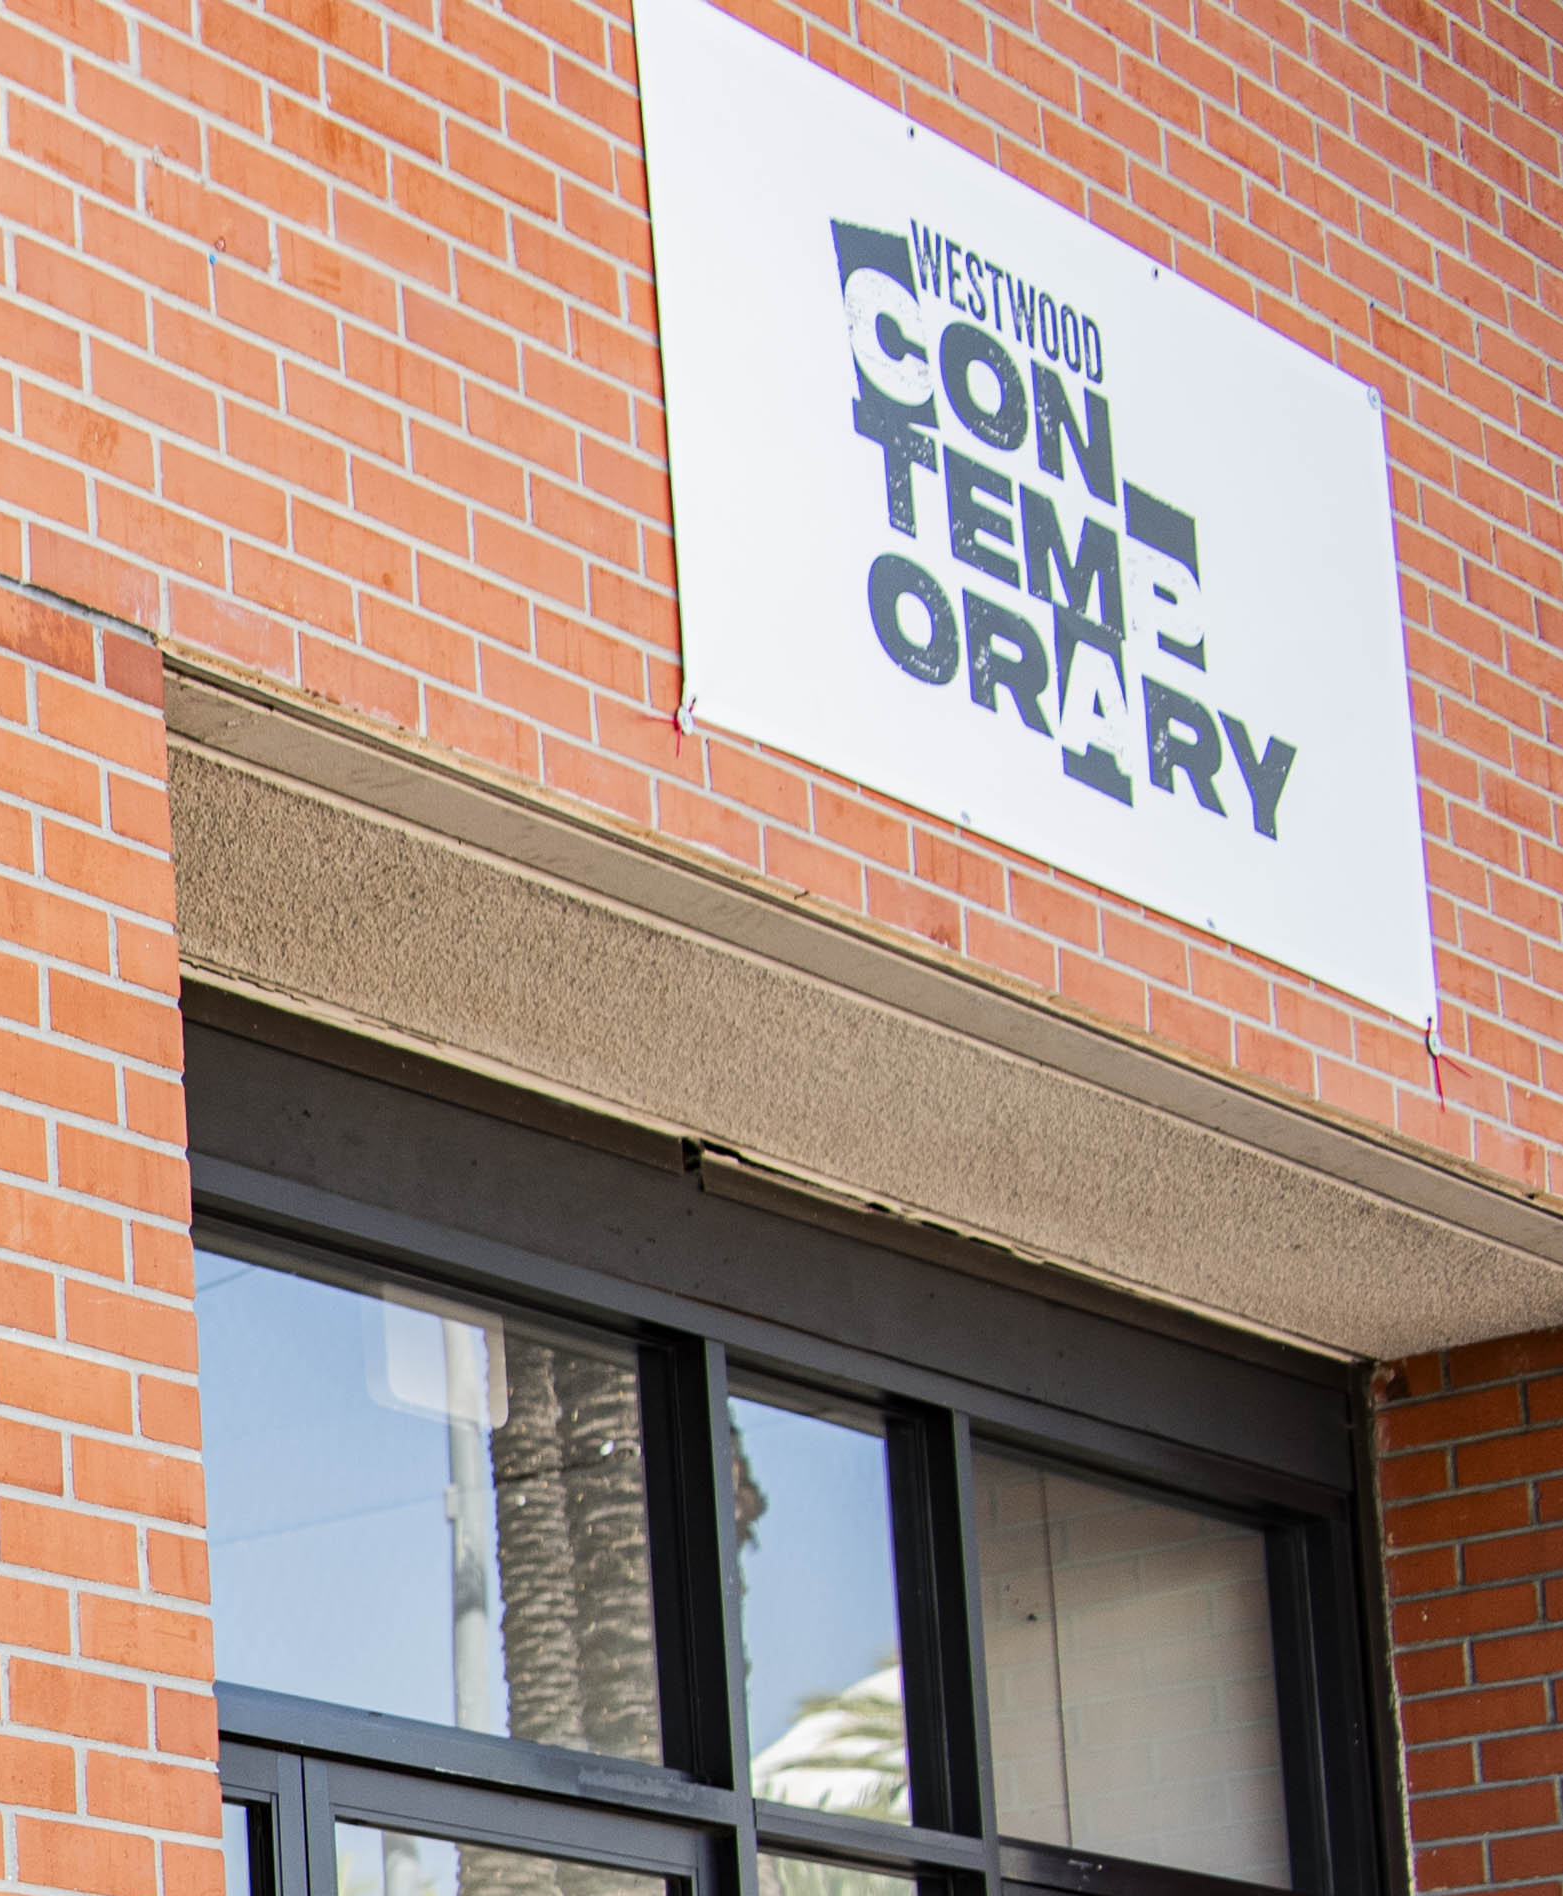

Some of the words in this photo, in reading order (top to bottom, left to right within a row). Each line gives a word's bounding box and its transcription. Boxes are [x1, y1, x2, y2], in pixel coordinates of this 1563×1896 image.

[840, 262, 1117, 507] CON
[911, 217, 1103, 385] WESTWOOD
[853, 397, 1206, 672] TEMP
[868, 553, 1298, 842] ORARY
